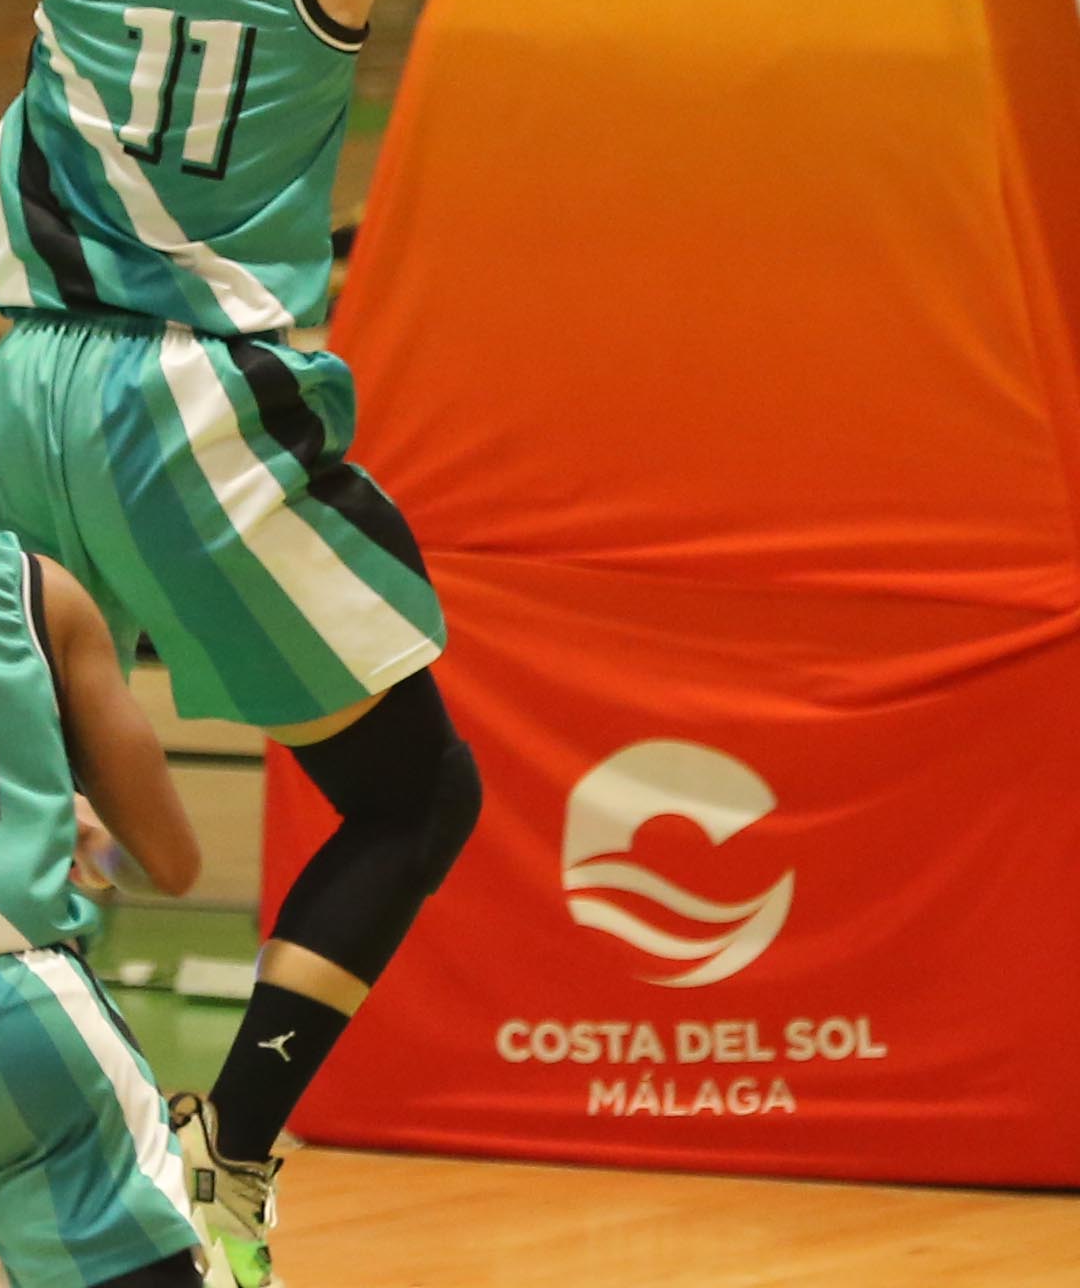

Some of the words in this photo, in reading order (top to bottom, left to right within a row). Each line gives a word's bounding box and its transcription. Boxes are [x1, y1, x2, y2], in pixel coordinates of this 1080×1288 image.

[119, 7, 256, 180] 11
[496, 1018, 665, 1064] COSTA
[675, 1021, 775, 1064] DEL
[784, 1016, 887, 1061] SOL
[586, 1070, 797, 1117] MÁLAGA
